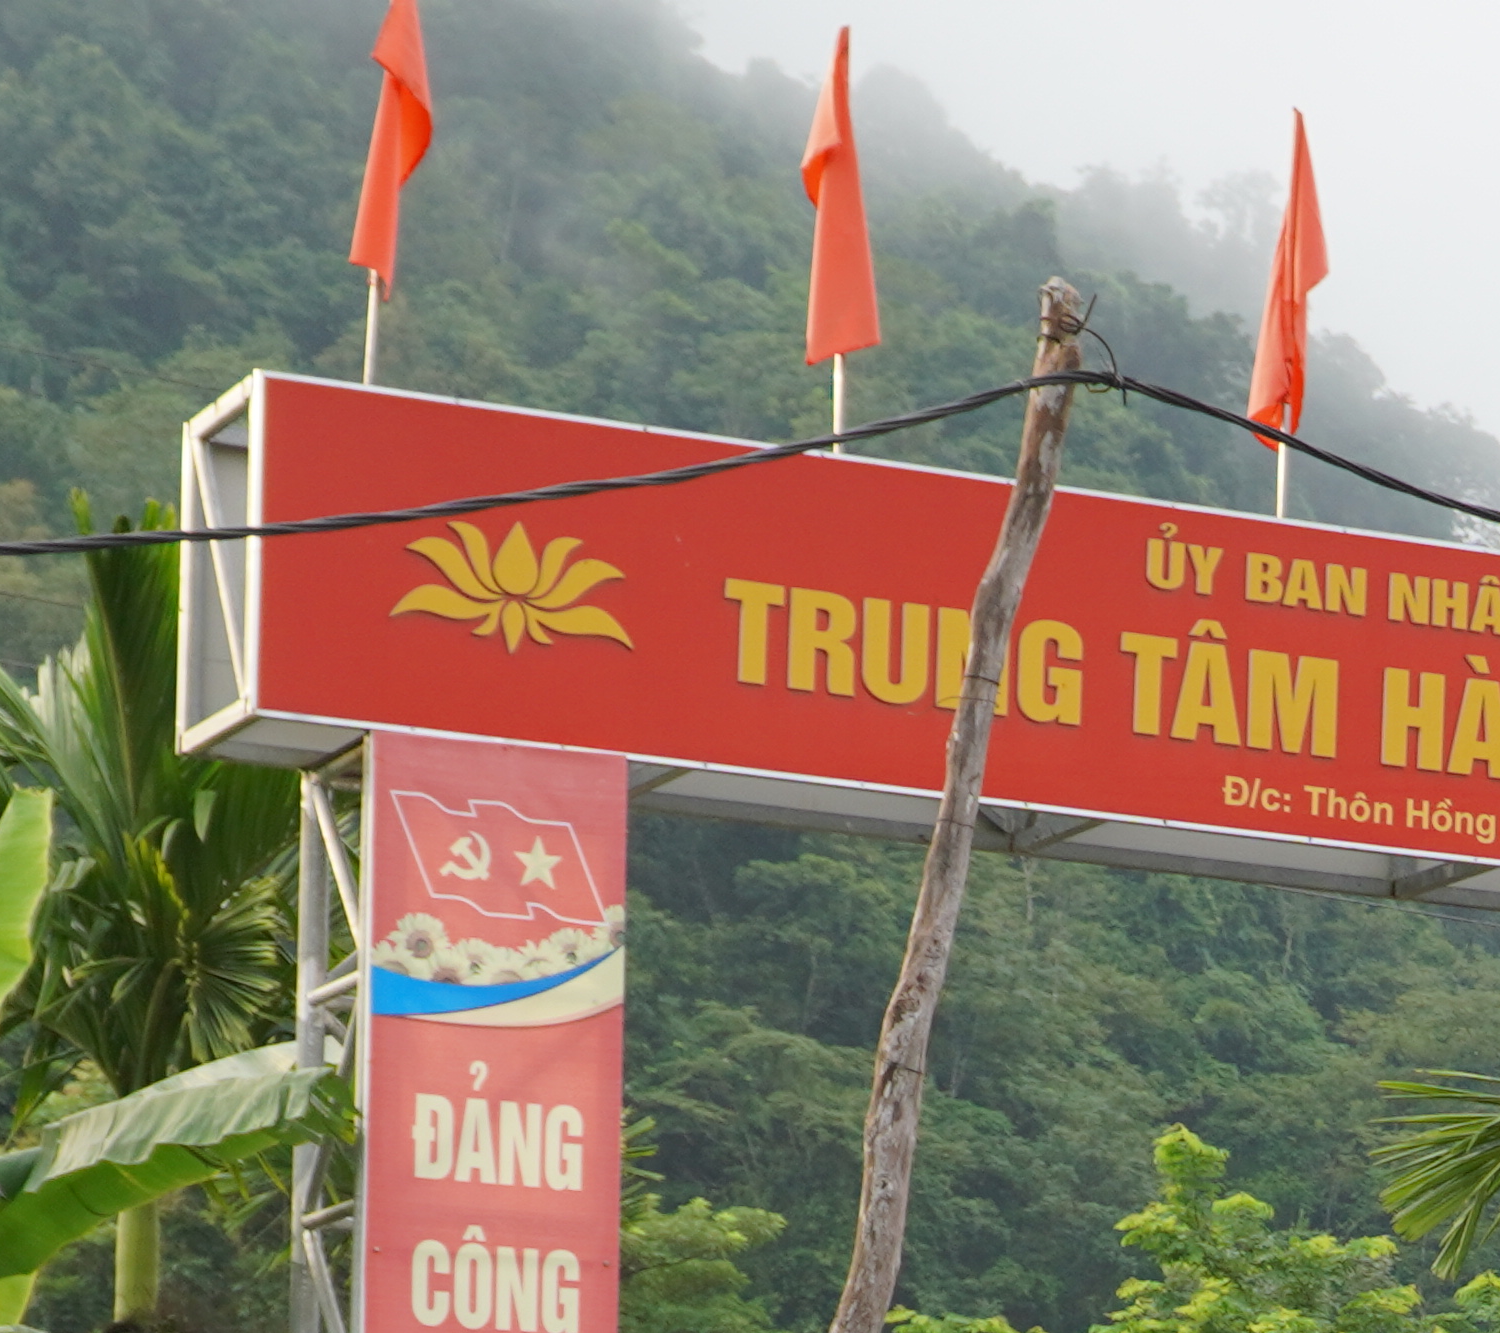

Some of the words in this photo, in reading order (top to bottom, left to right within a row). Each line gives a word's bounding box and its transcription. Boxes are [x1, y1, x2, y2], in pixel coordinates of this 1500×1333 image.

[1147, 522, 1225, 597] ỦY
[1246, 552, 1369, 618] BAN
[724, 578, 1086, 727] TRUNG
[1121, 619, 1341, 760] TÂM
[1222, 775, 1293, 813] Đ/c:
[1303, 785, 1396, 827] Thôn
[1406, 797, 1499, 845] Hồng
[411, 1059, 586, 1194] ĐẢNG
